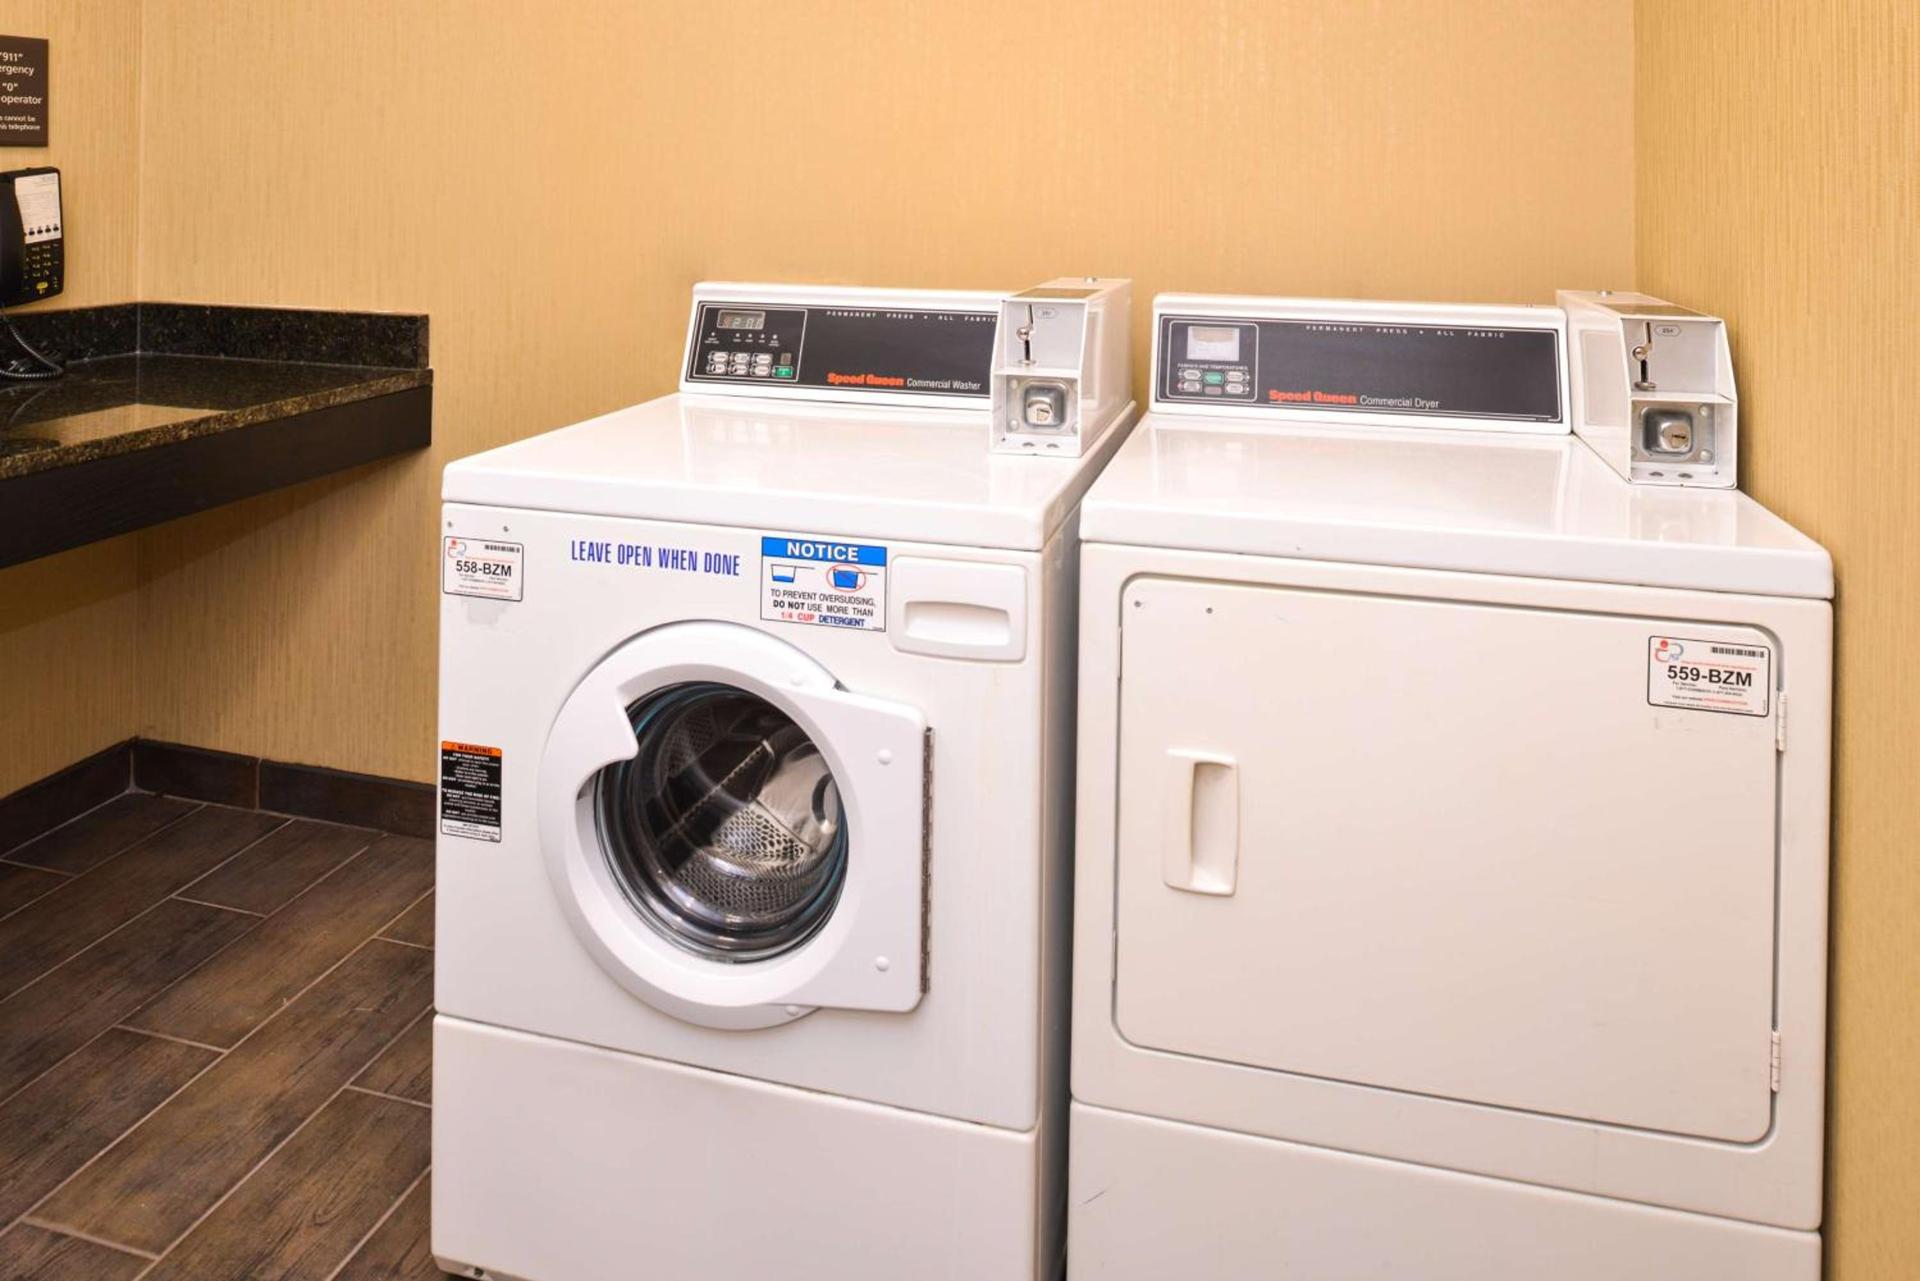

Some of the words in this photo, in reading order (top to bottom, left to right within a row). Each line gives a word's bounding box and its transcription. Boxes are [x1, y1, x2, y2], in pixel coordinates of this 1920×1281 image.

[1, 96, 41, 105] operator
[827, 372, 866, 385] Speed
[867, 374, 904, 387] Queen
[906, 378, 950, 389] Commercial
[952, 381, 982, 391] Washer
[1269, 389, 1311, 402] Speed
[1313, 391, 1357, 404] Queen
[1360, 394, 1412, 407] Commercial
[1415, 397, 1439, 409] Dryer
[572, 540, 612, 563] LEAVE
[617, 543, 652, 567] OPEN
[658, 547, 697, 572] WHEN
[704, 552, 740, 576] DONE
[787, 542, 859, 561] NOTICE
[456, 560, 512, 577] 558-BZM
[771, 588, 780, 597] TO
[783, 590, 817, 601] PREVENT
[773, 600, 785, 608] DO
[788, 601, 805, 610] NOT
[807, 603, 823, 612] USE
[826, 605, 849, 615] MORE
[852, 607, 874, 617] THAN
[797, 612, 815, 621] CUP
[819, 615, 865, 627] DETERGENT
[1667, 665, 1752, 687] 559-BZM
[457, 744, 493, 755] WARNING
